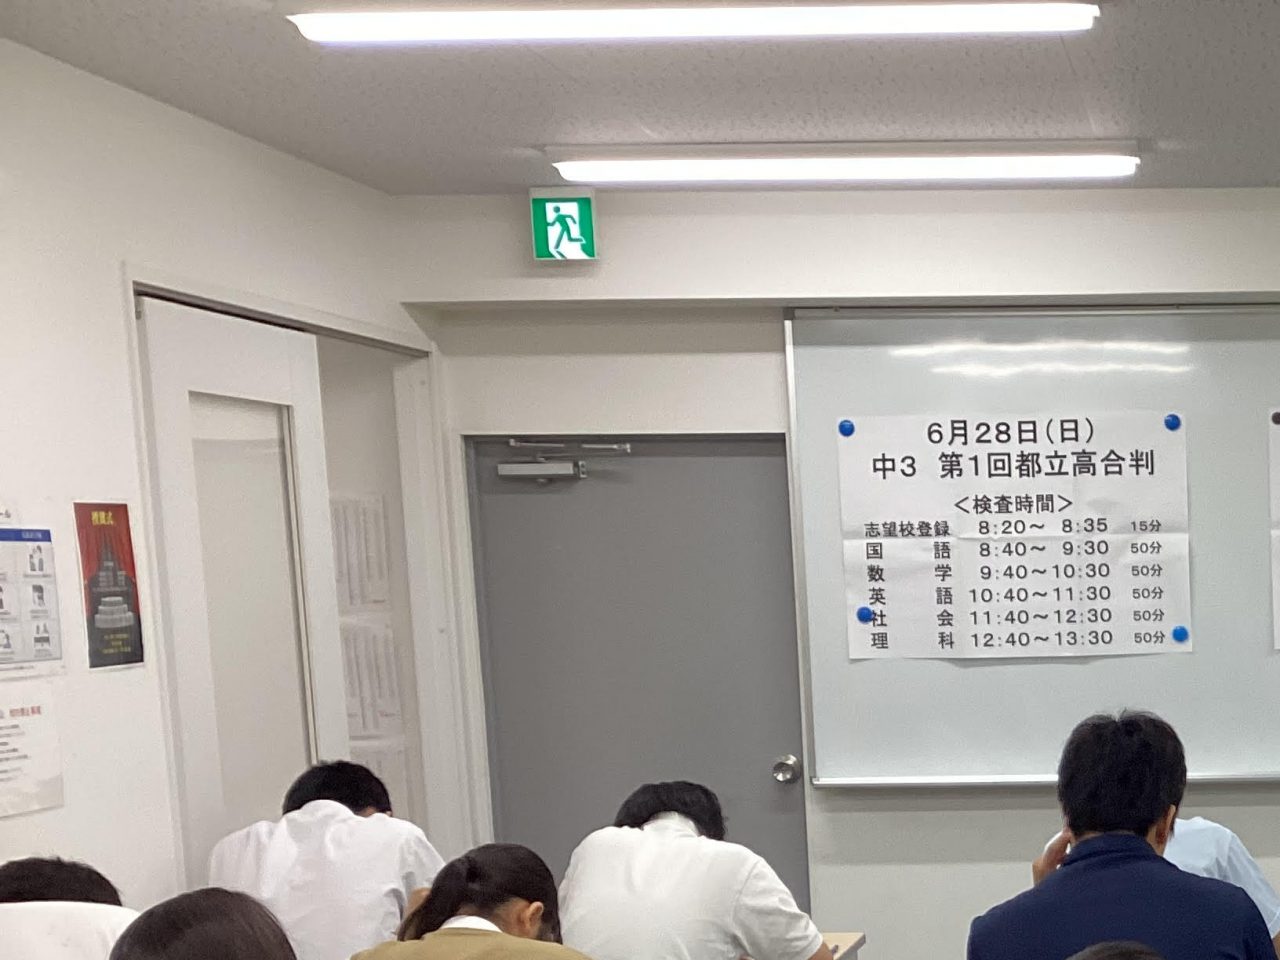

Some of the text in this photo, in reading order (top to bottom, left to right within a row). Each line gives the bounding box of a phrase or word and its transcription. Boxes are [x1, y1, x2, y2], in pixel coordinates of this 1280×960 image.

[863, 520, 951, 538] 志望校登録
